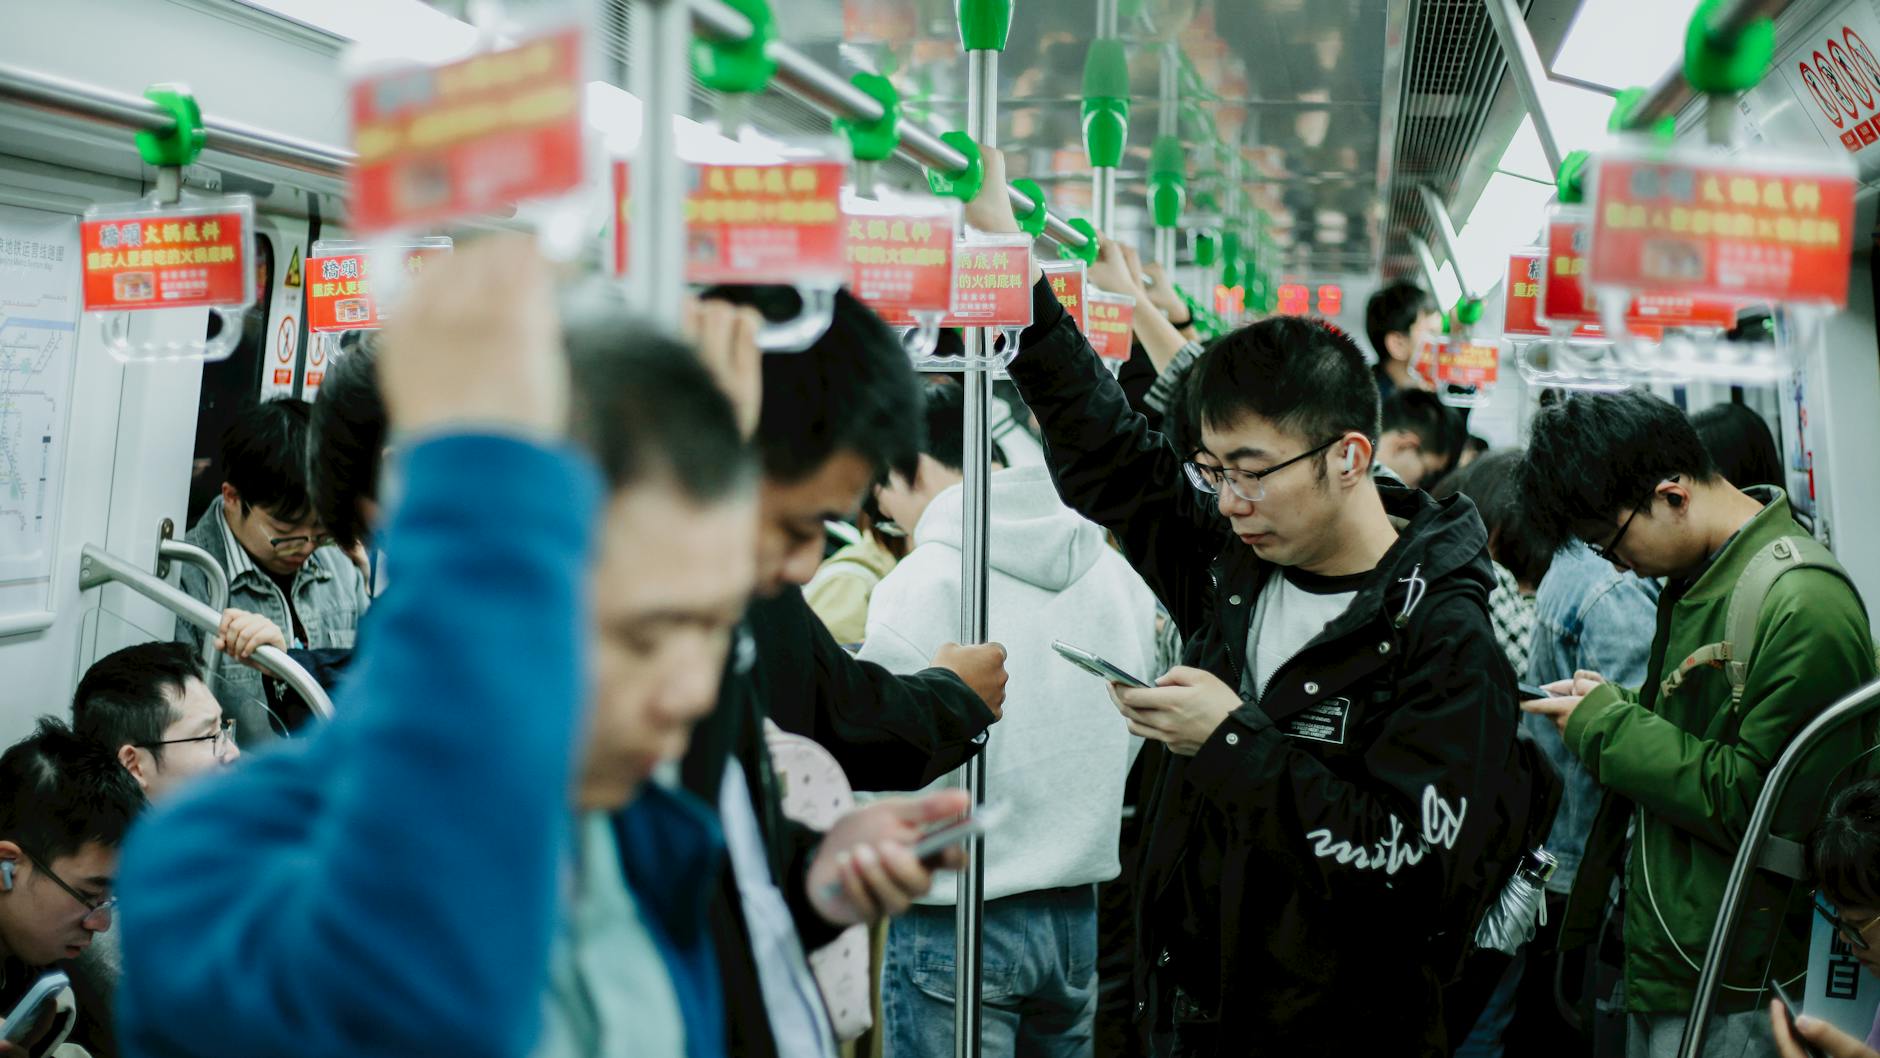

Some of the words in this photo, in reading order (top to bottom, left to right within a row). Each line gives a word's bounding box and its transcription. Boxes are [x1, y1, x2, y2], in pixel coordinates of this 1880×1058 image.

[144, 220, 220, 244] 火锅底料
[322, 258, 359, 280] 橋頭
